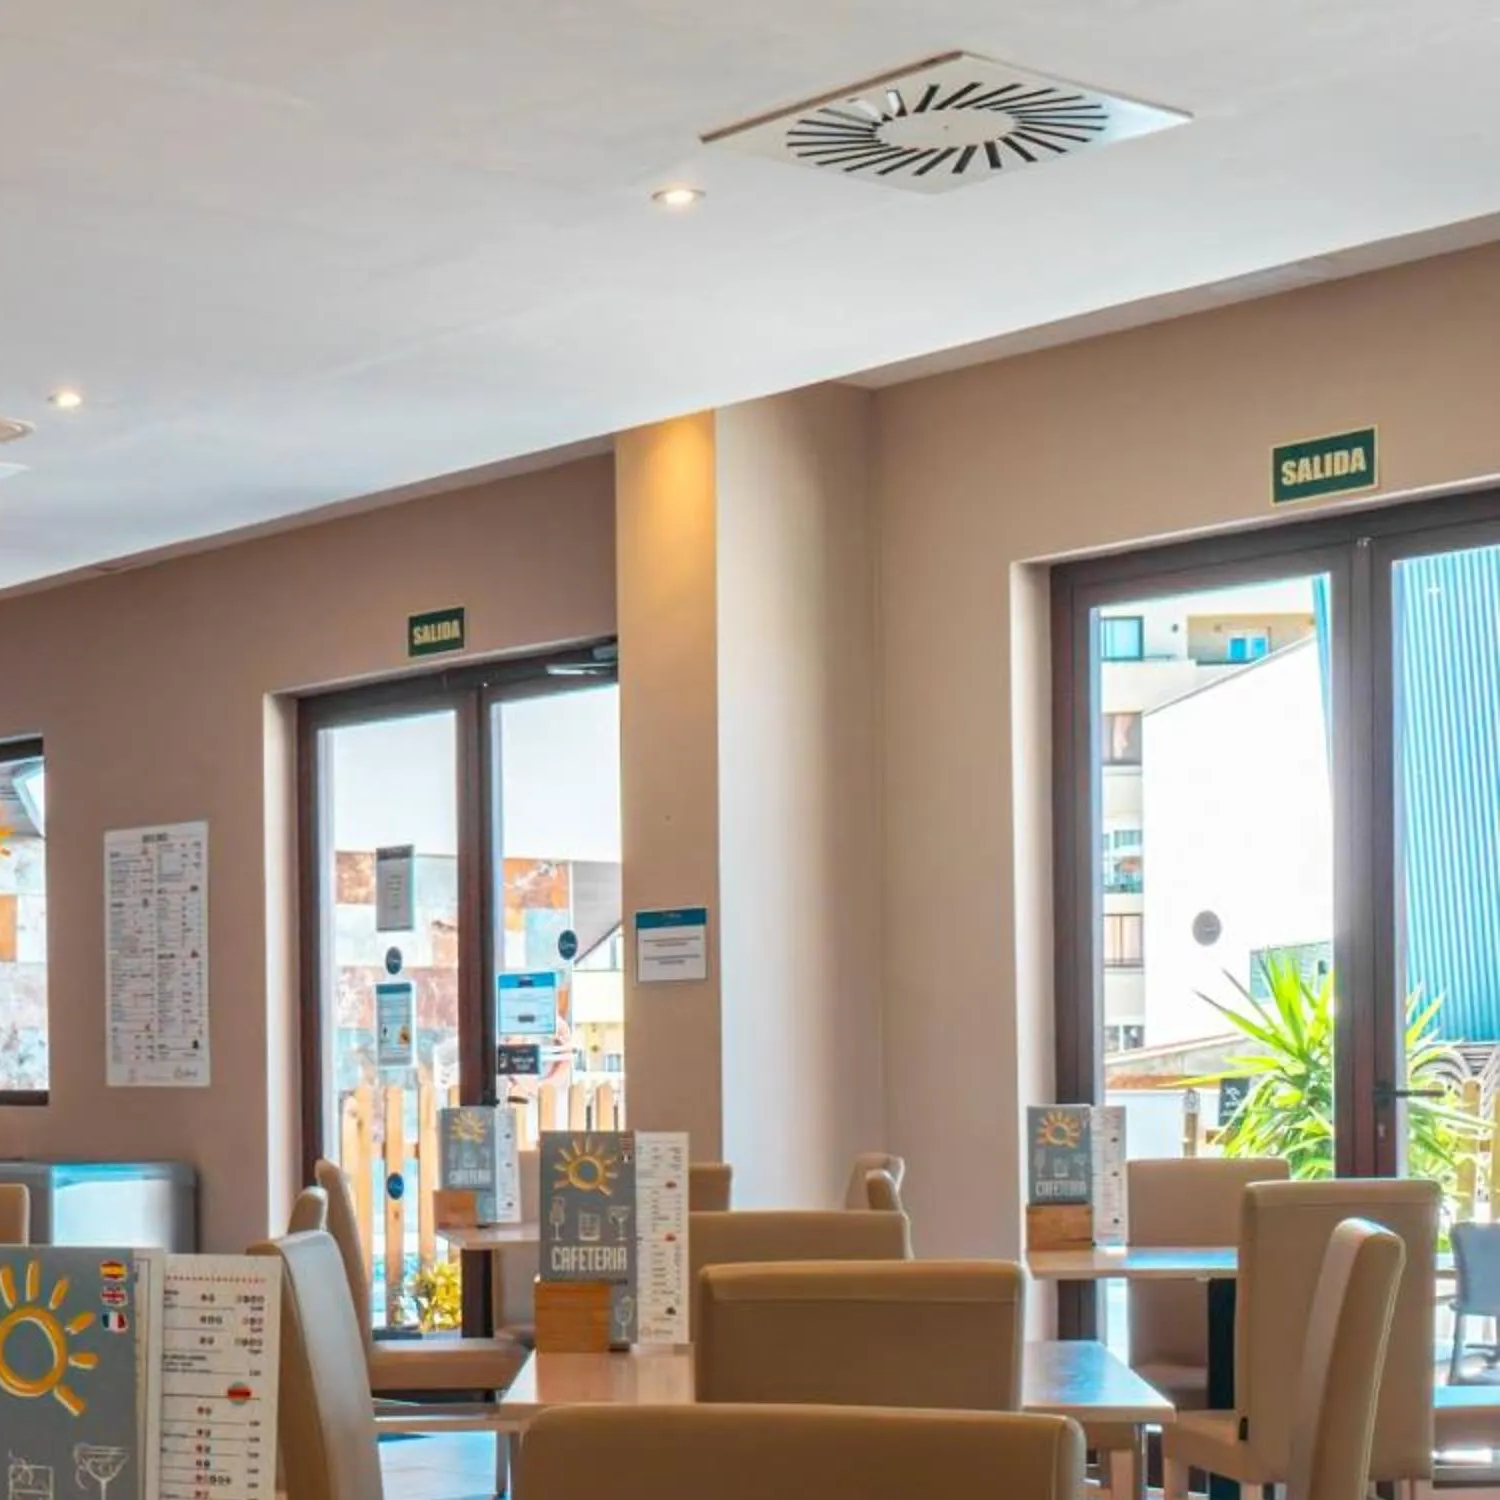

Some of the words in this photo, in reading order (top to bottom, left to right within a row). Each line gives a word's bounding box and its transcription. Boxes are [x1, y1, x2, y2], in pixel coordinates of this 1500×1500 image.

[1282, 447, 1367, 486] SALIDA
[413, 620, 461, 645] SALIDA
[551, 1246, 627, 1272] CAFETERIA
